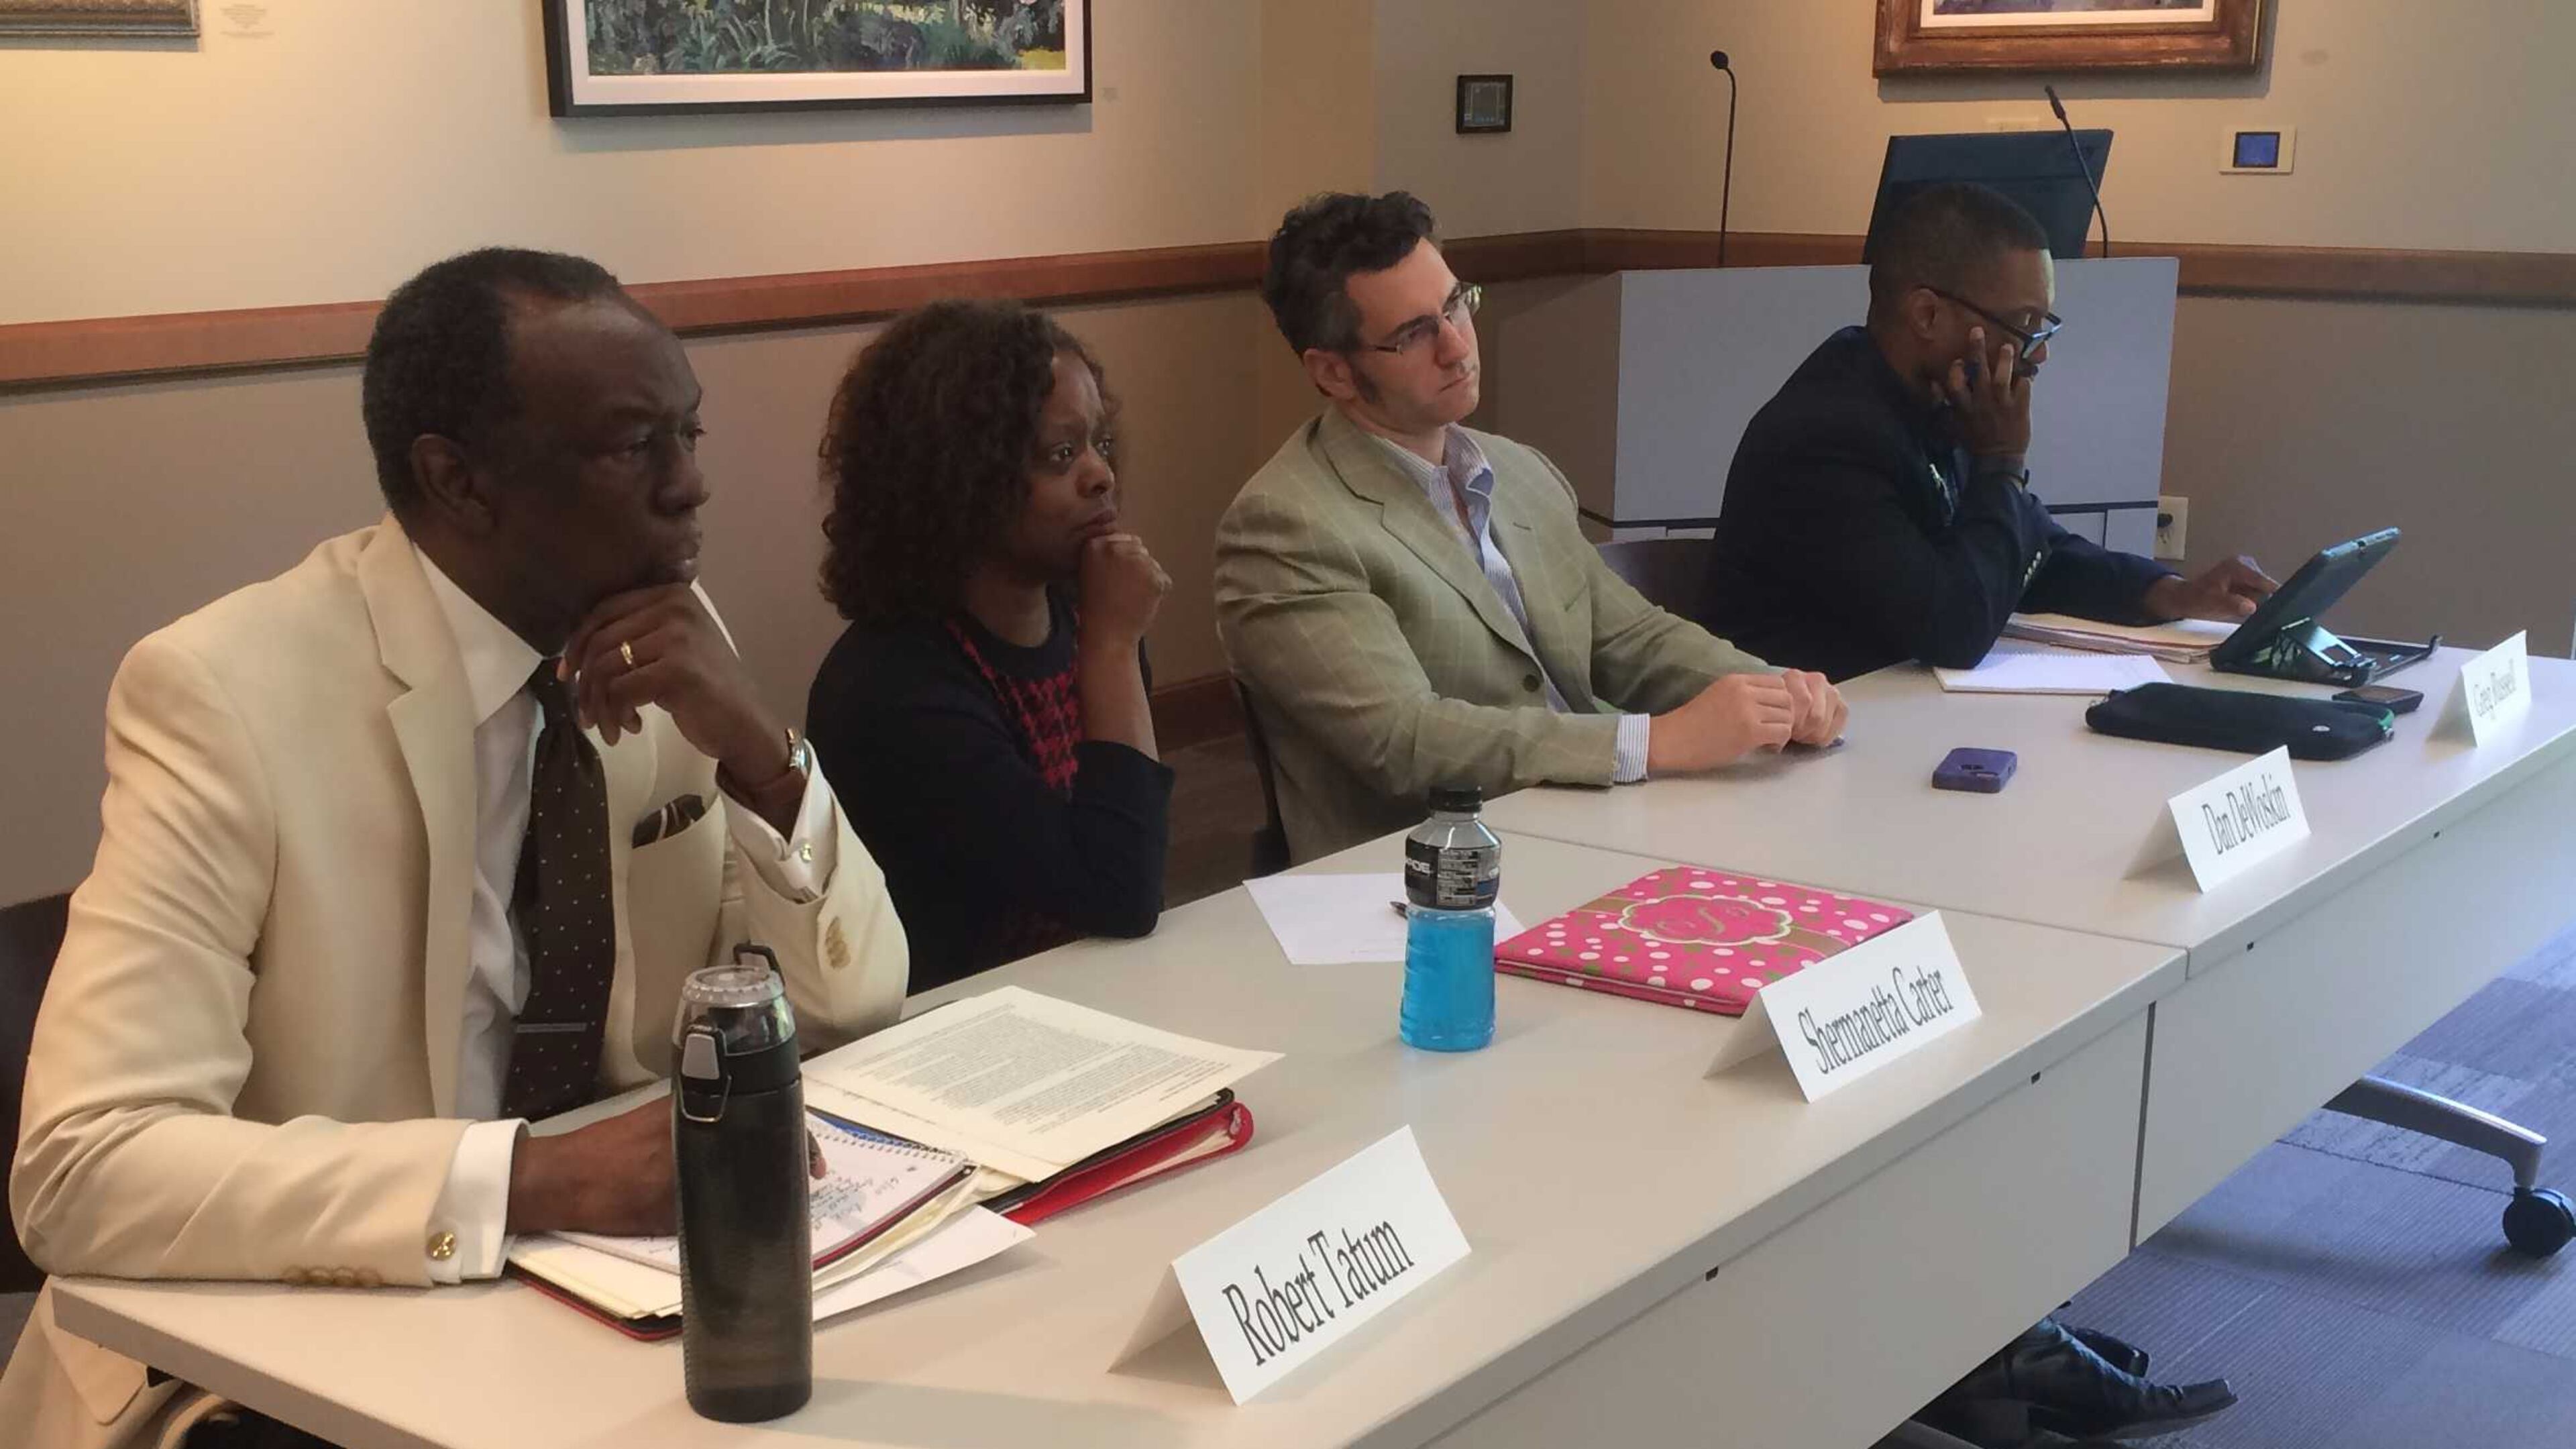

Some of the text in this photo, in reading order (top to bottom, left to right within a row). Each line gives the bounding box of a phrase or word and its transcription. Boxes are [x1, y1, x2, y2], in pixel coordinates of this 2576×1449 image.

[2201, 773, 2291, 855] Dan DeWoskin
[1797, 965, 1954, 1075] Shermanetta Carter
[1221, 1220, 1415, 1366] Robert Tatum
